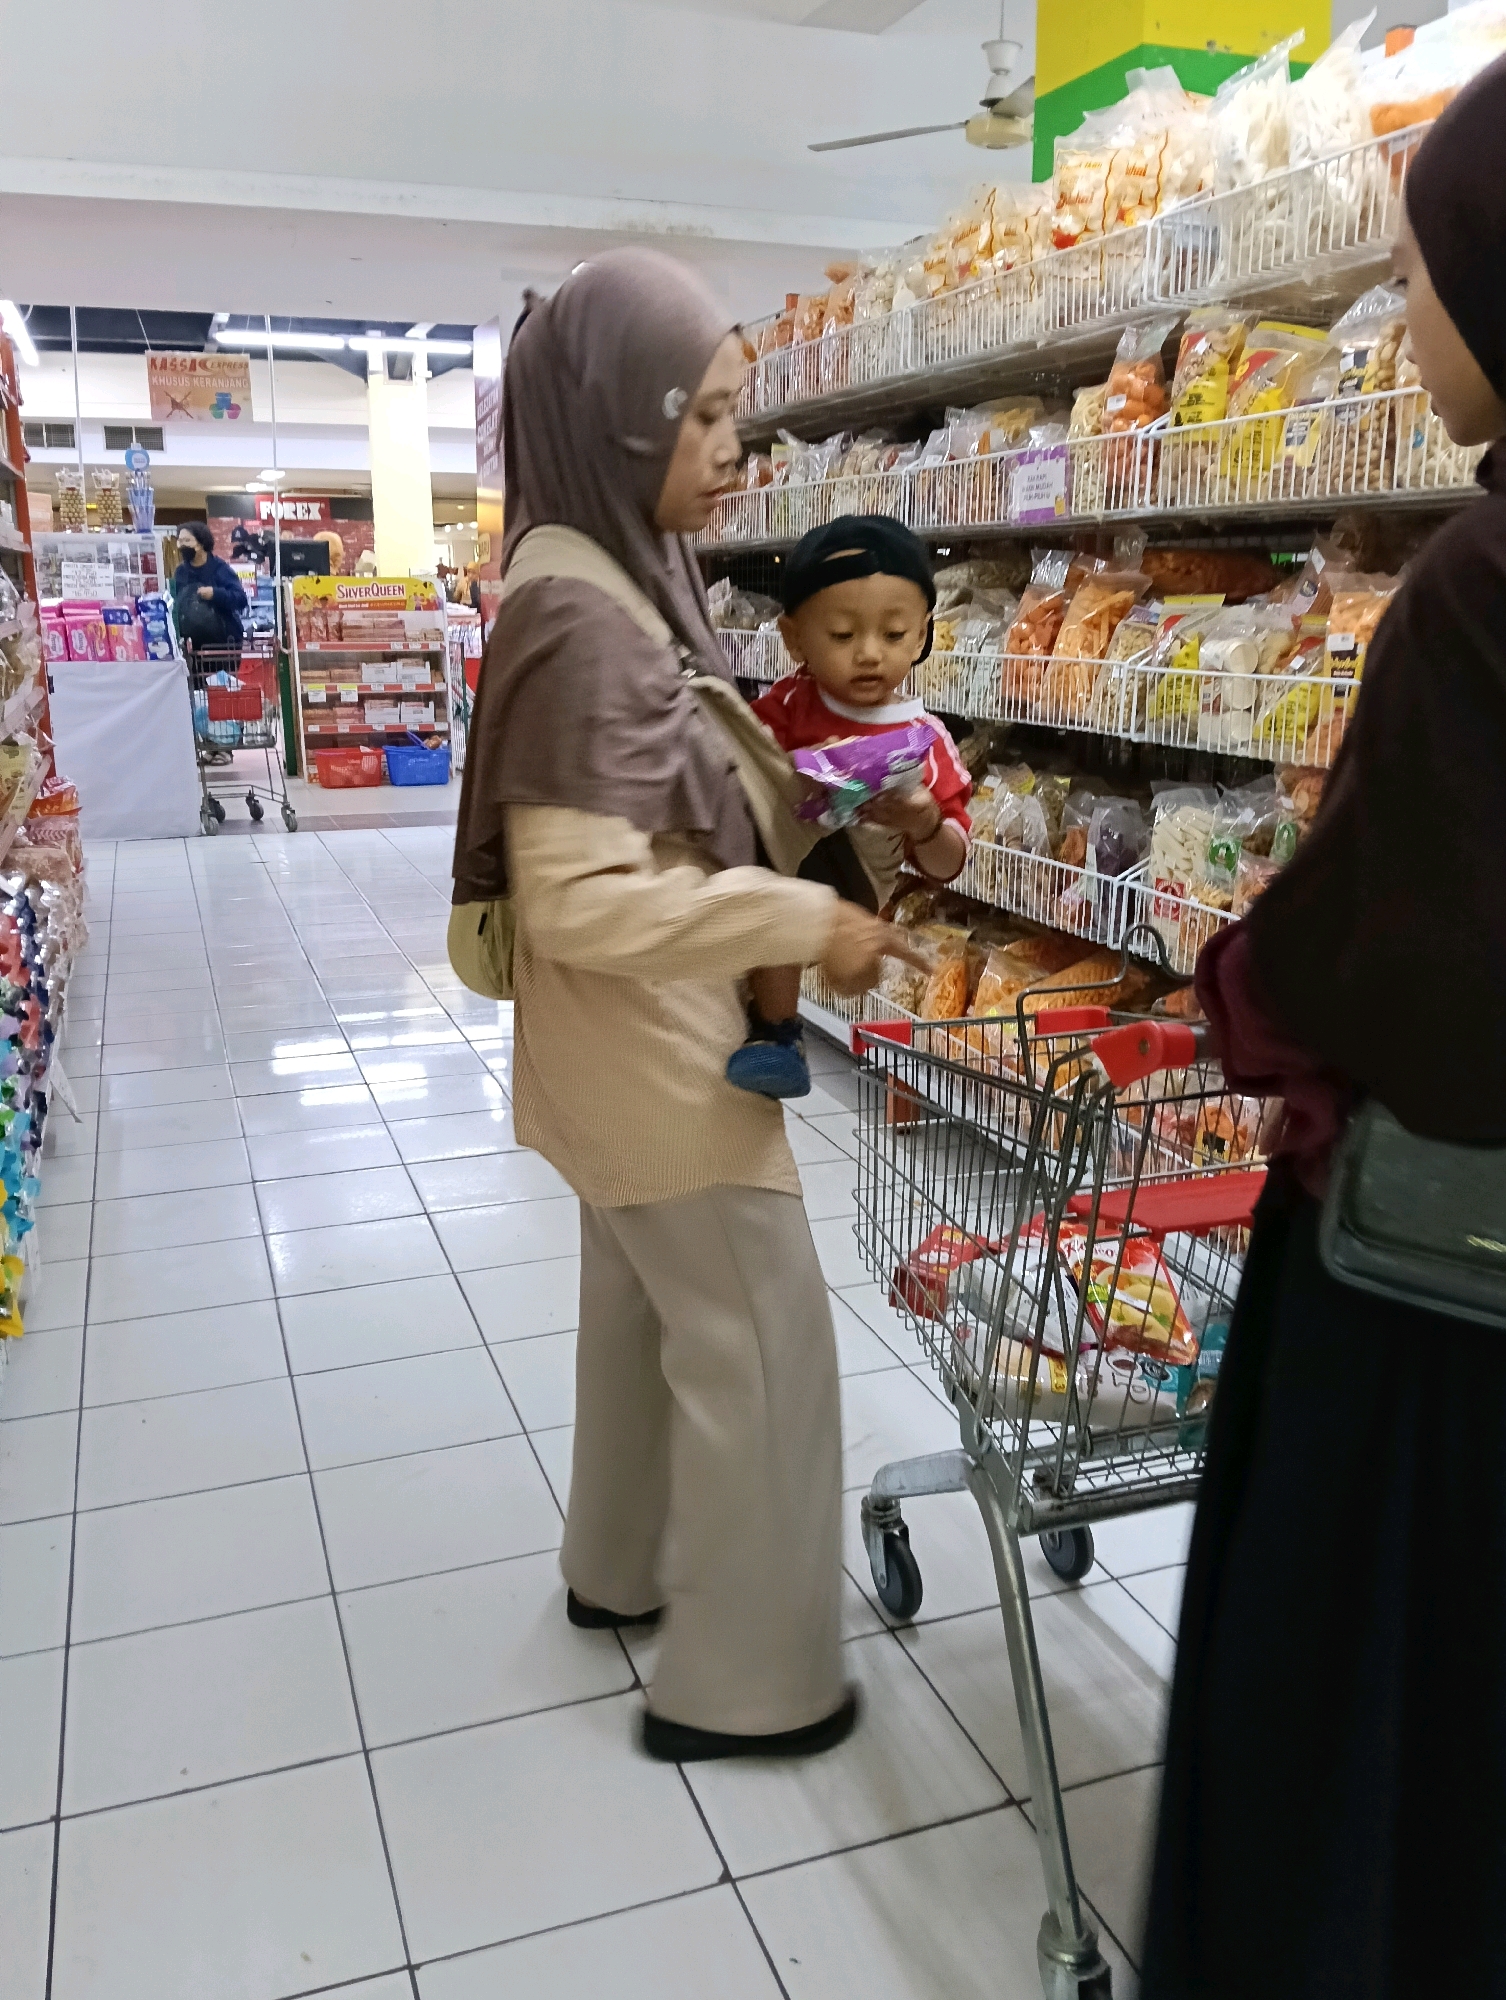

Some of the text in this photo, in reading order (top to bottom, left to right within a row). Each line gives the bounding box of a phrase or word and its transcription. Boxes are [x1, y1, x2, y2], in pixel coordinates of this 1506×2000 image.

[150, 356, 249, 372] KASSA EXPRESS
[152, 376, 249, 388] KHUSUS KERANJANG
